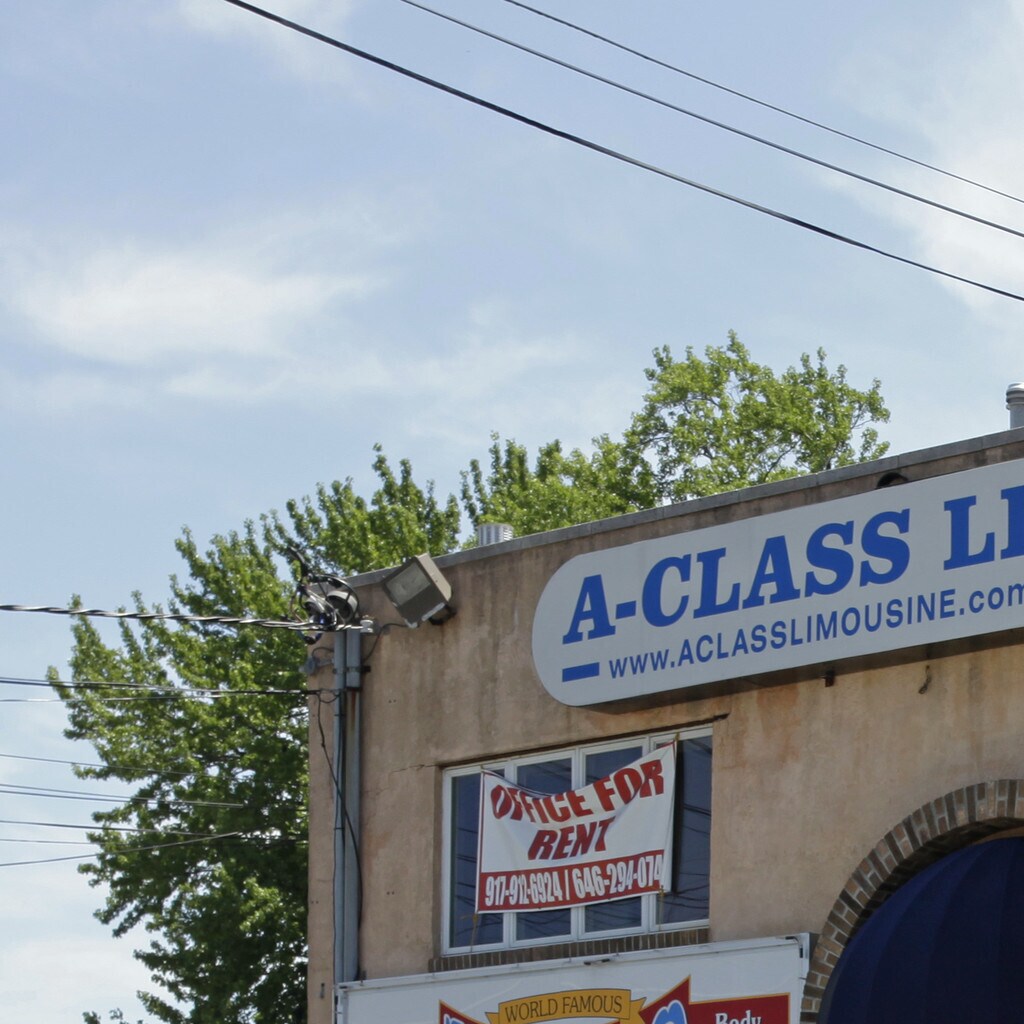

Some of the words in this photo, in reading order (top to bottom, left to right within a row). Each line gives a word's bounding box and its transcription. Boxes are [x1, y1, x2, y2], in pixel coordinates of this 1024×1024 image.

[563, 508, 910, 644] A-CLASS
[490, 785, 594, 823] OFFICE
[592, 759, 665, 812] FOR
[527, 816, 616, 861] RENT
[504, 996, 558, 1023] WORLD
[562, 994, 623, 1015] FAMOUS
